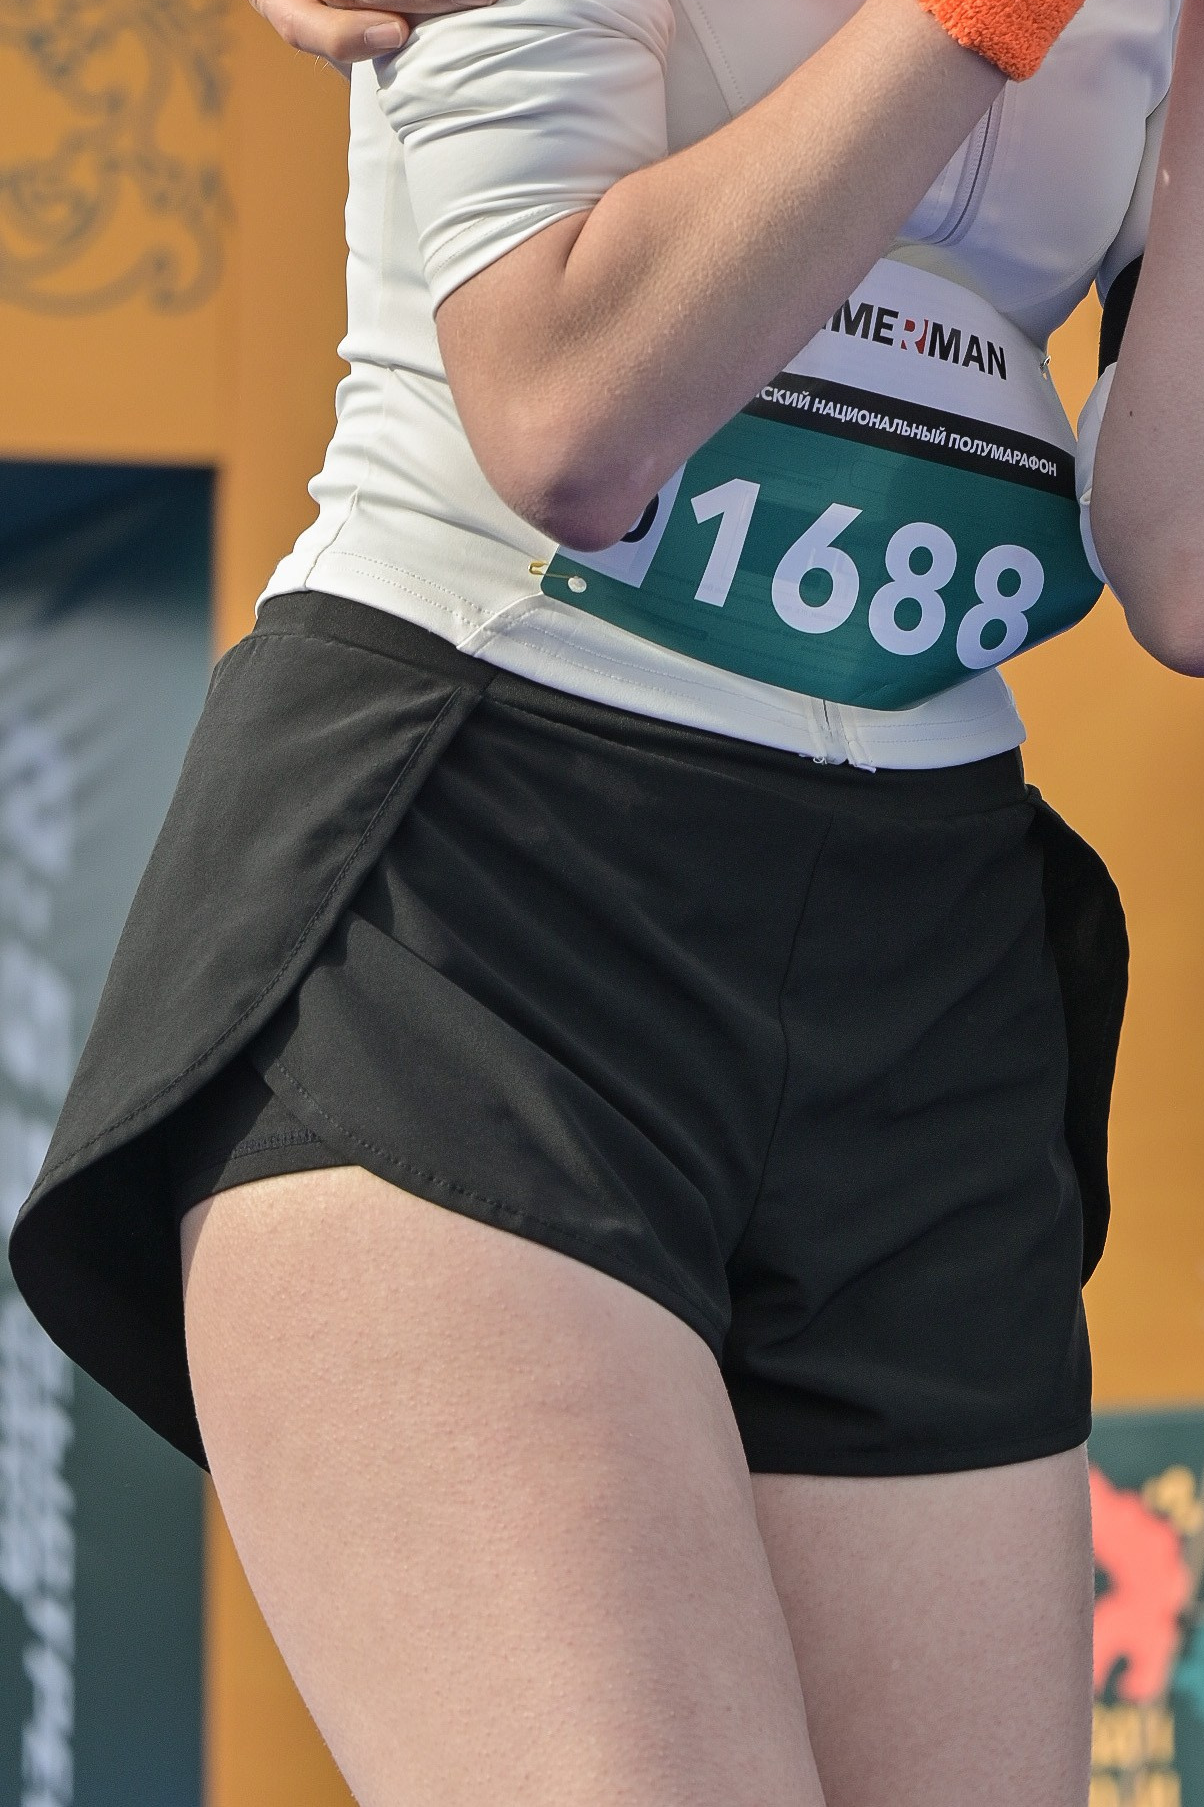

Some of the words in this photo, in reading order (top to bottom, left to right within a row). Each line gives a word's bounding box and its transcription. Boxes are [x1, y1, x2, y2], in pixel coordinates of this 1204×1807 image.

[821, 299, 1007, 380] MERMAN
[756, 386, 812, 411] СКИЙ
[812, 398, 947, 445] НАЦИОНАЛЬНЫЙ
[948, 433, 1058, 477] ПОЛУМАРАФОН
[690, 478, 1045, 670] 1688
